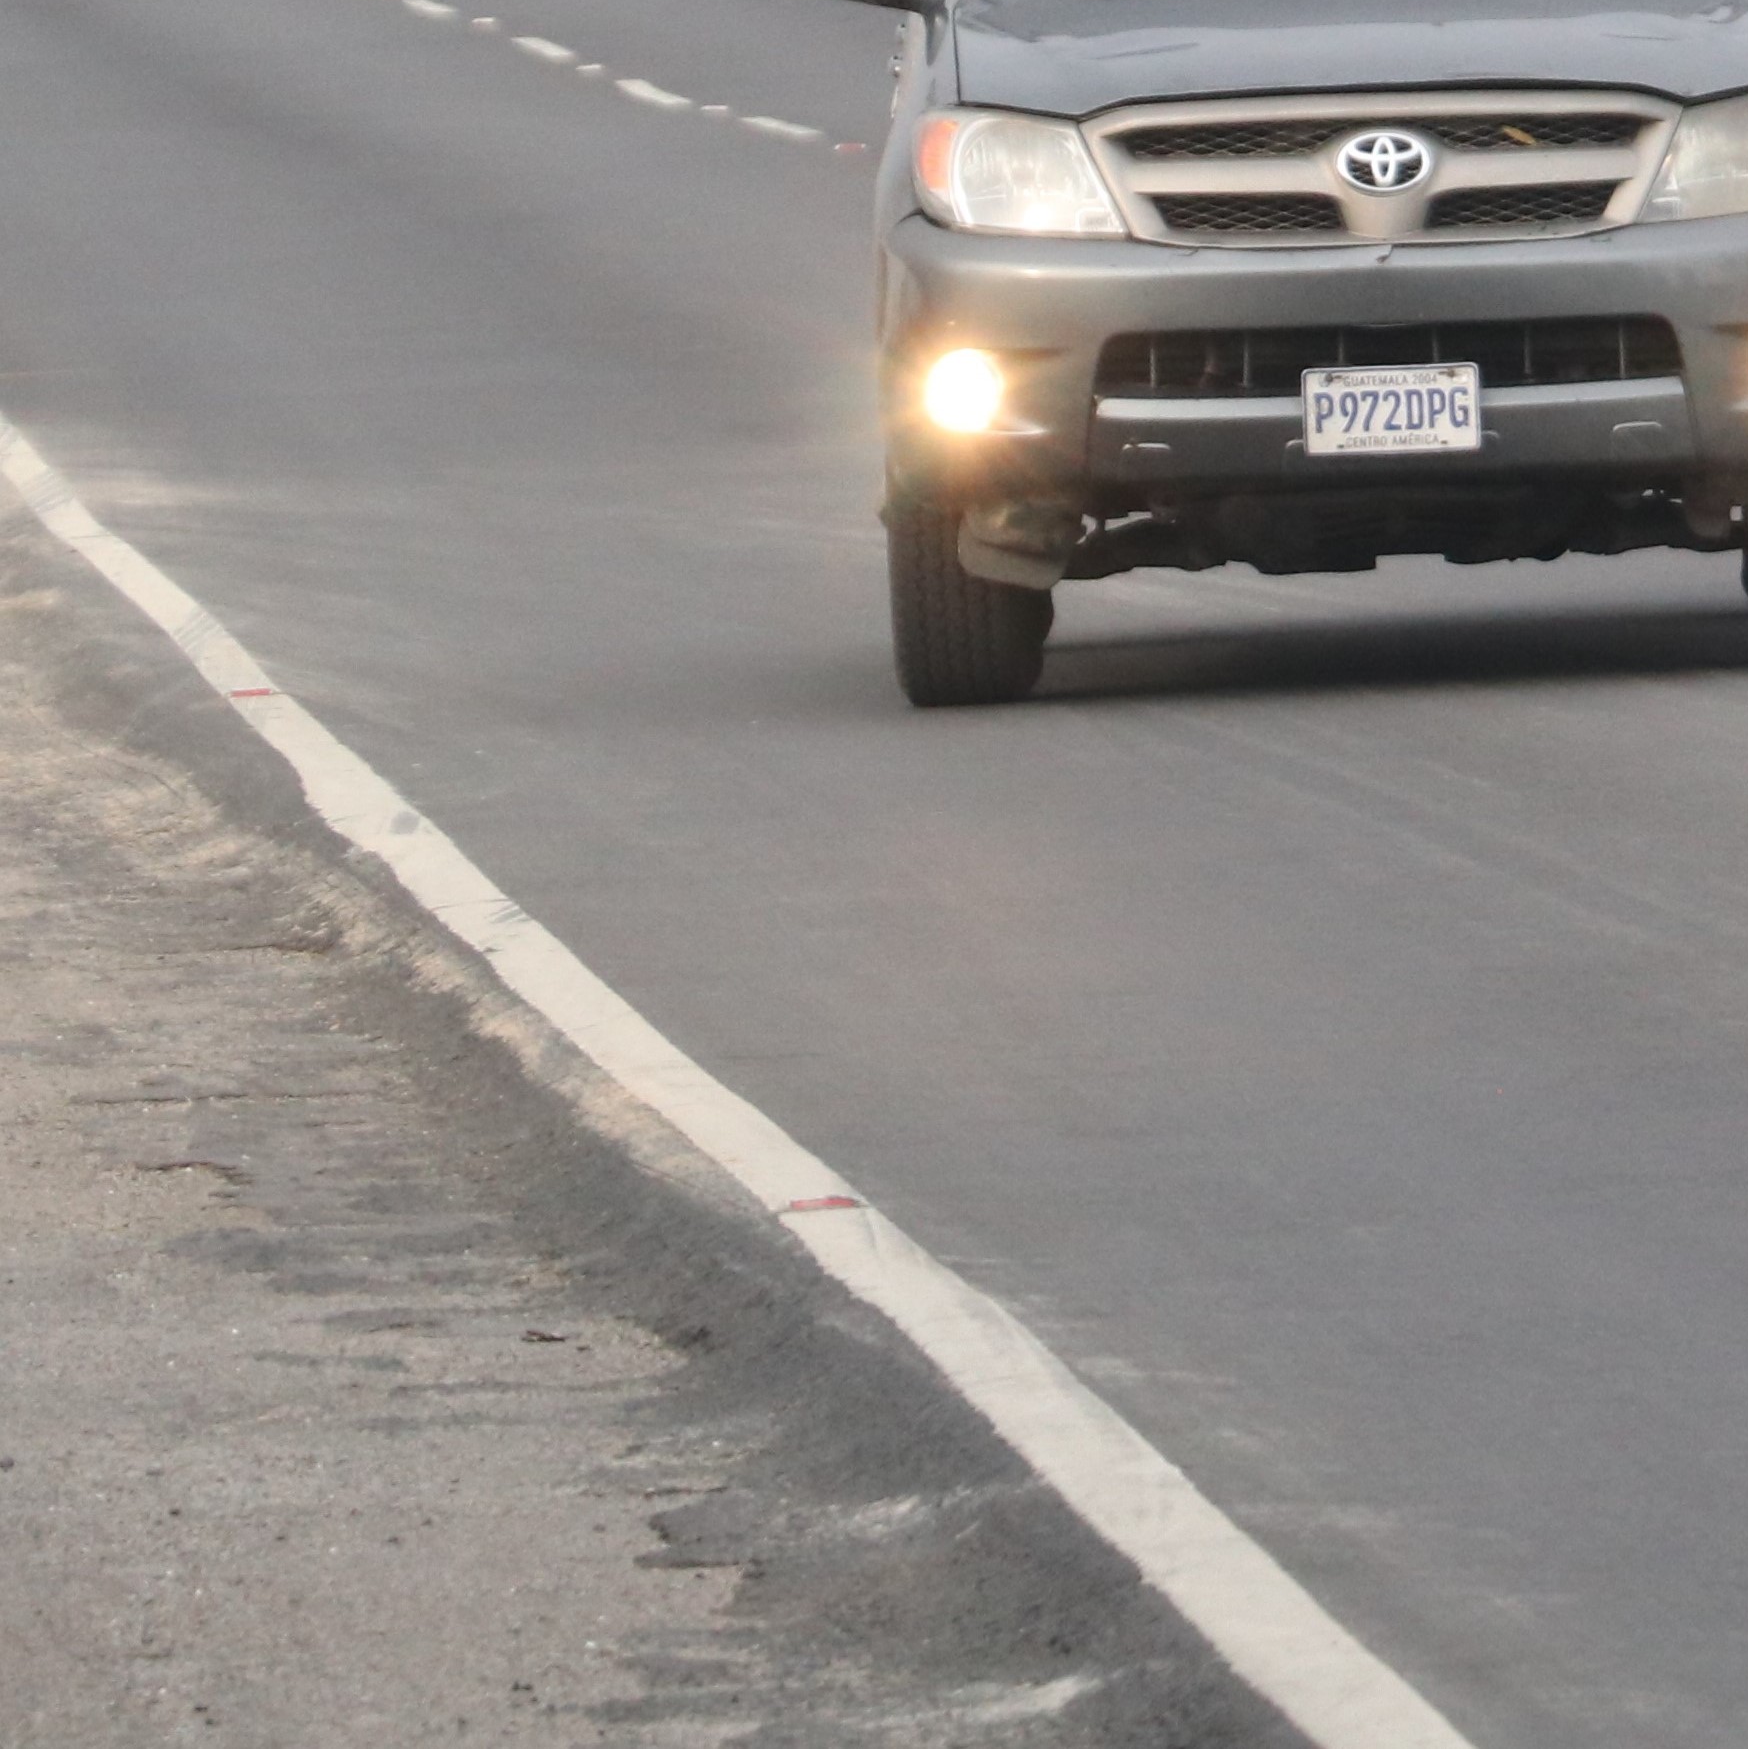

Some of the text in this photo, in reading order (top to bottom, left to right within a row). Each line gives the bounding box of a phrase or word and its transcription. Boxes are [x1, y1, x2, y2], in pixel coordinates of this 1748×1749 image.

[1343, 372, 1437, 387] GUATEMALA 2004
[1314, 386, 1470, 434] P972DPG
[1345, 433, 1439, 448] CENTRO AMÉRICA
